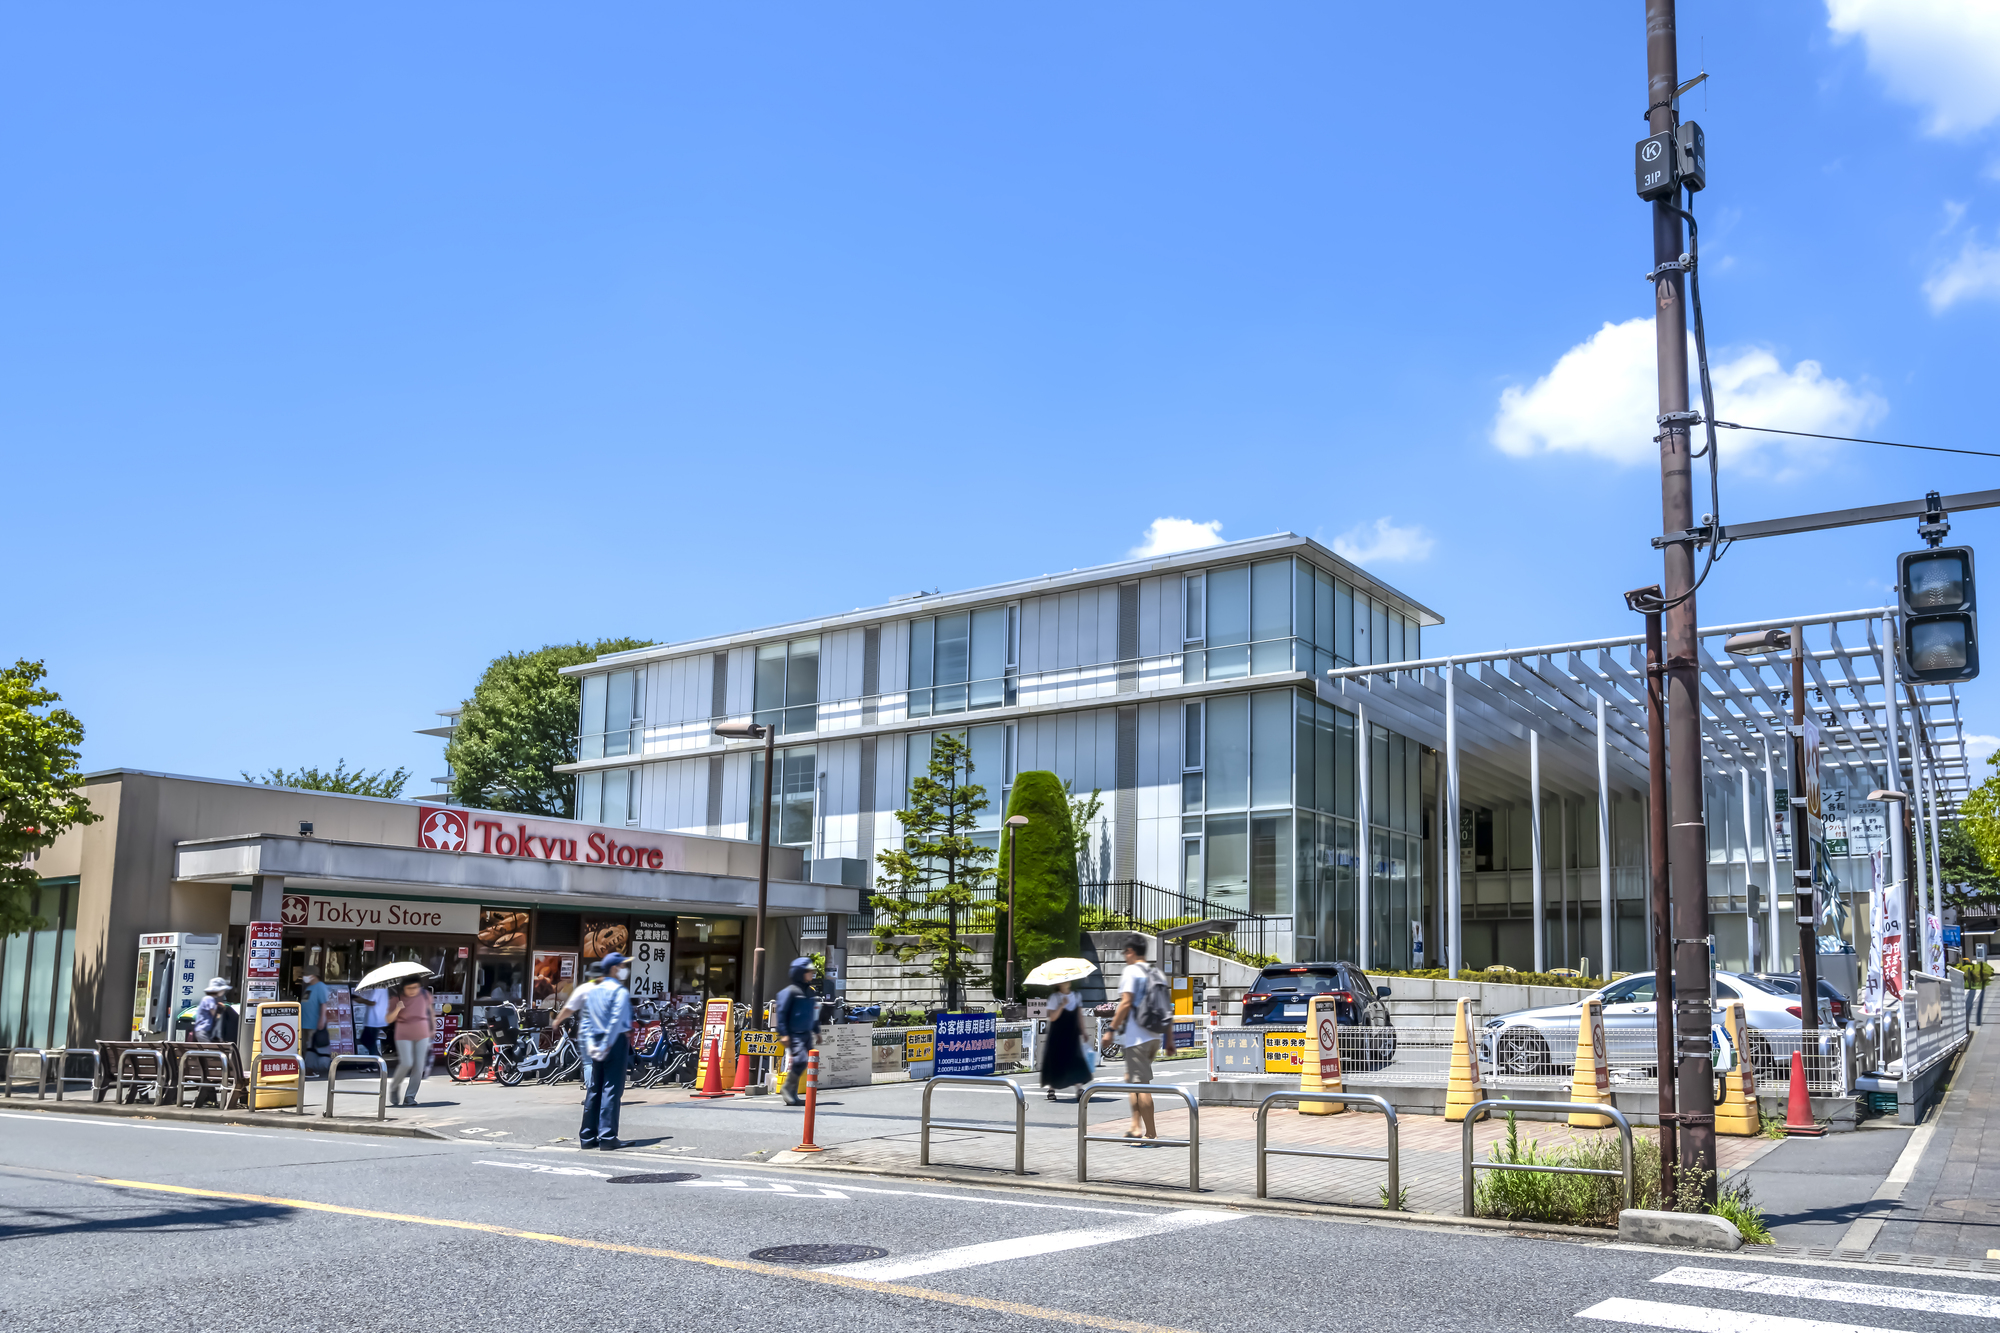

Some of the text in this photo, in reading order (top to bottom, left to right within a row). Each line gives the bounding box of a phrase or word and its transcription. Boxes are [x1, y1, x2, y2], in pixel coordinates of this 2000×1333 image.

[474, 820, 664, 870] Tokyu Store
[313, 901, 442, 927] Tokyu Store
[635, 929, 670, 941] 営業時間
[638, 942, 666, 963] 8時
[181, 959, 196, 1009] 証明写真
[634, 976, 665, 995] 24時
[938, 1018, 996, 1035] お客様専用駐車場
[1040, 1021, 1046, 1034] P
[263, 1063, 296, 1072] 駐輪禁止
[1225, 1055, 1251, 1065] 禁止
